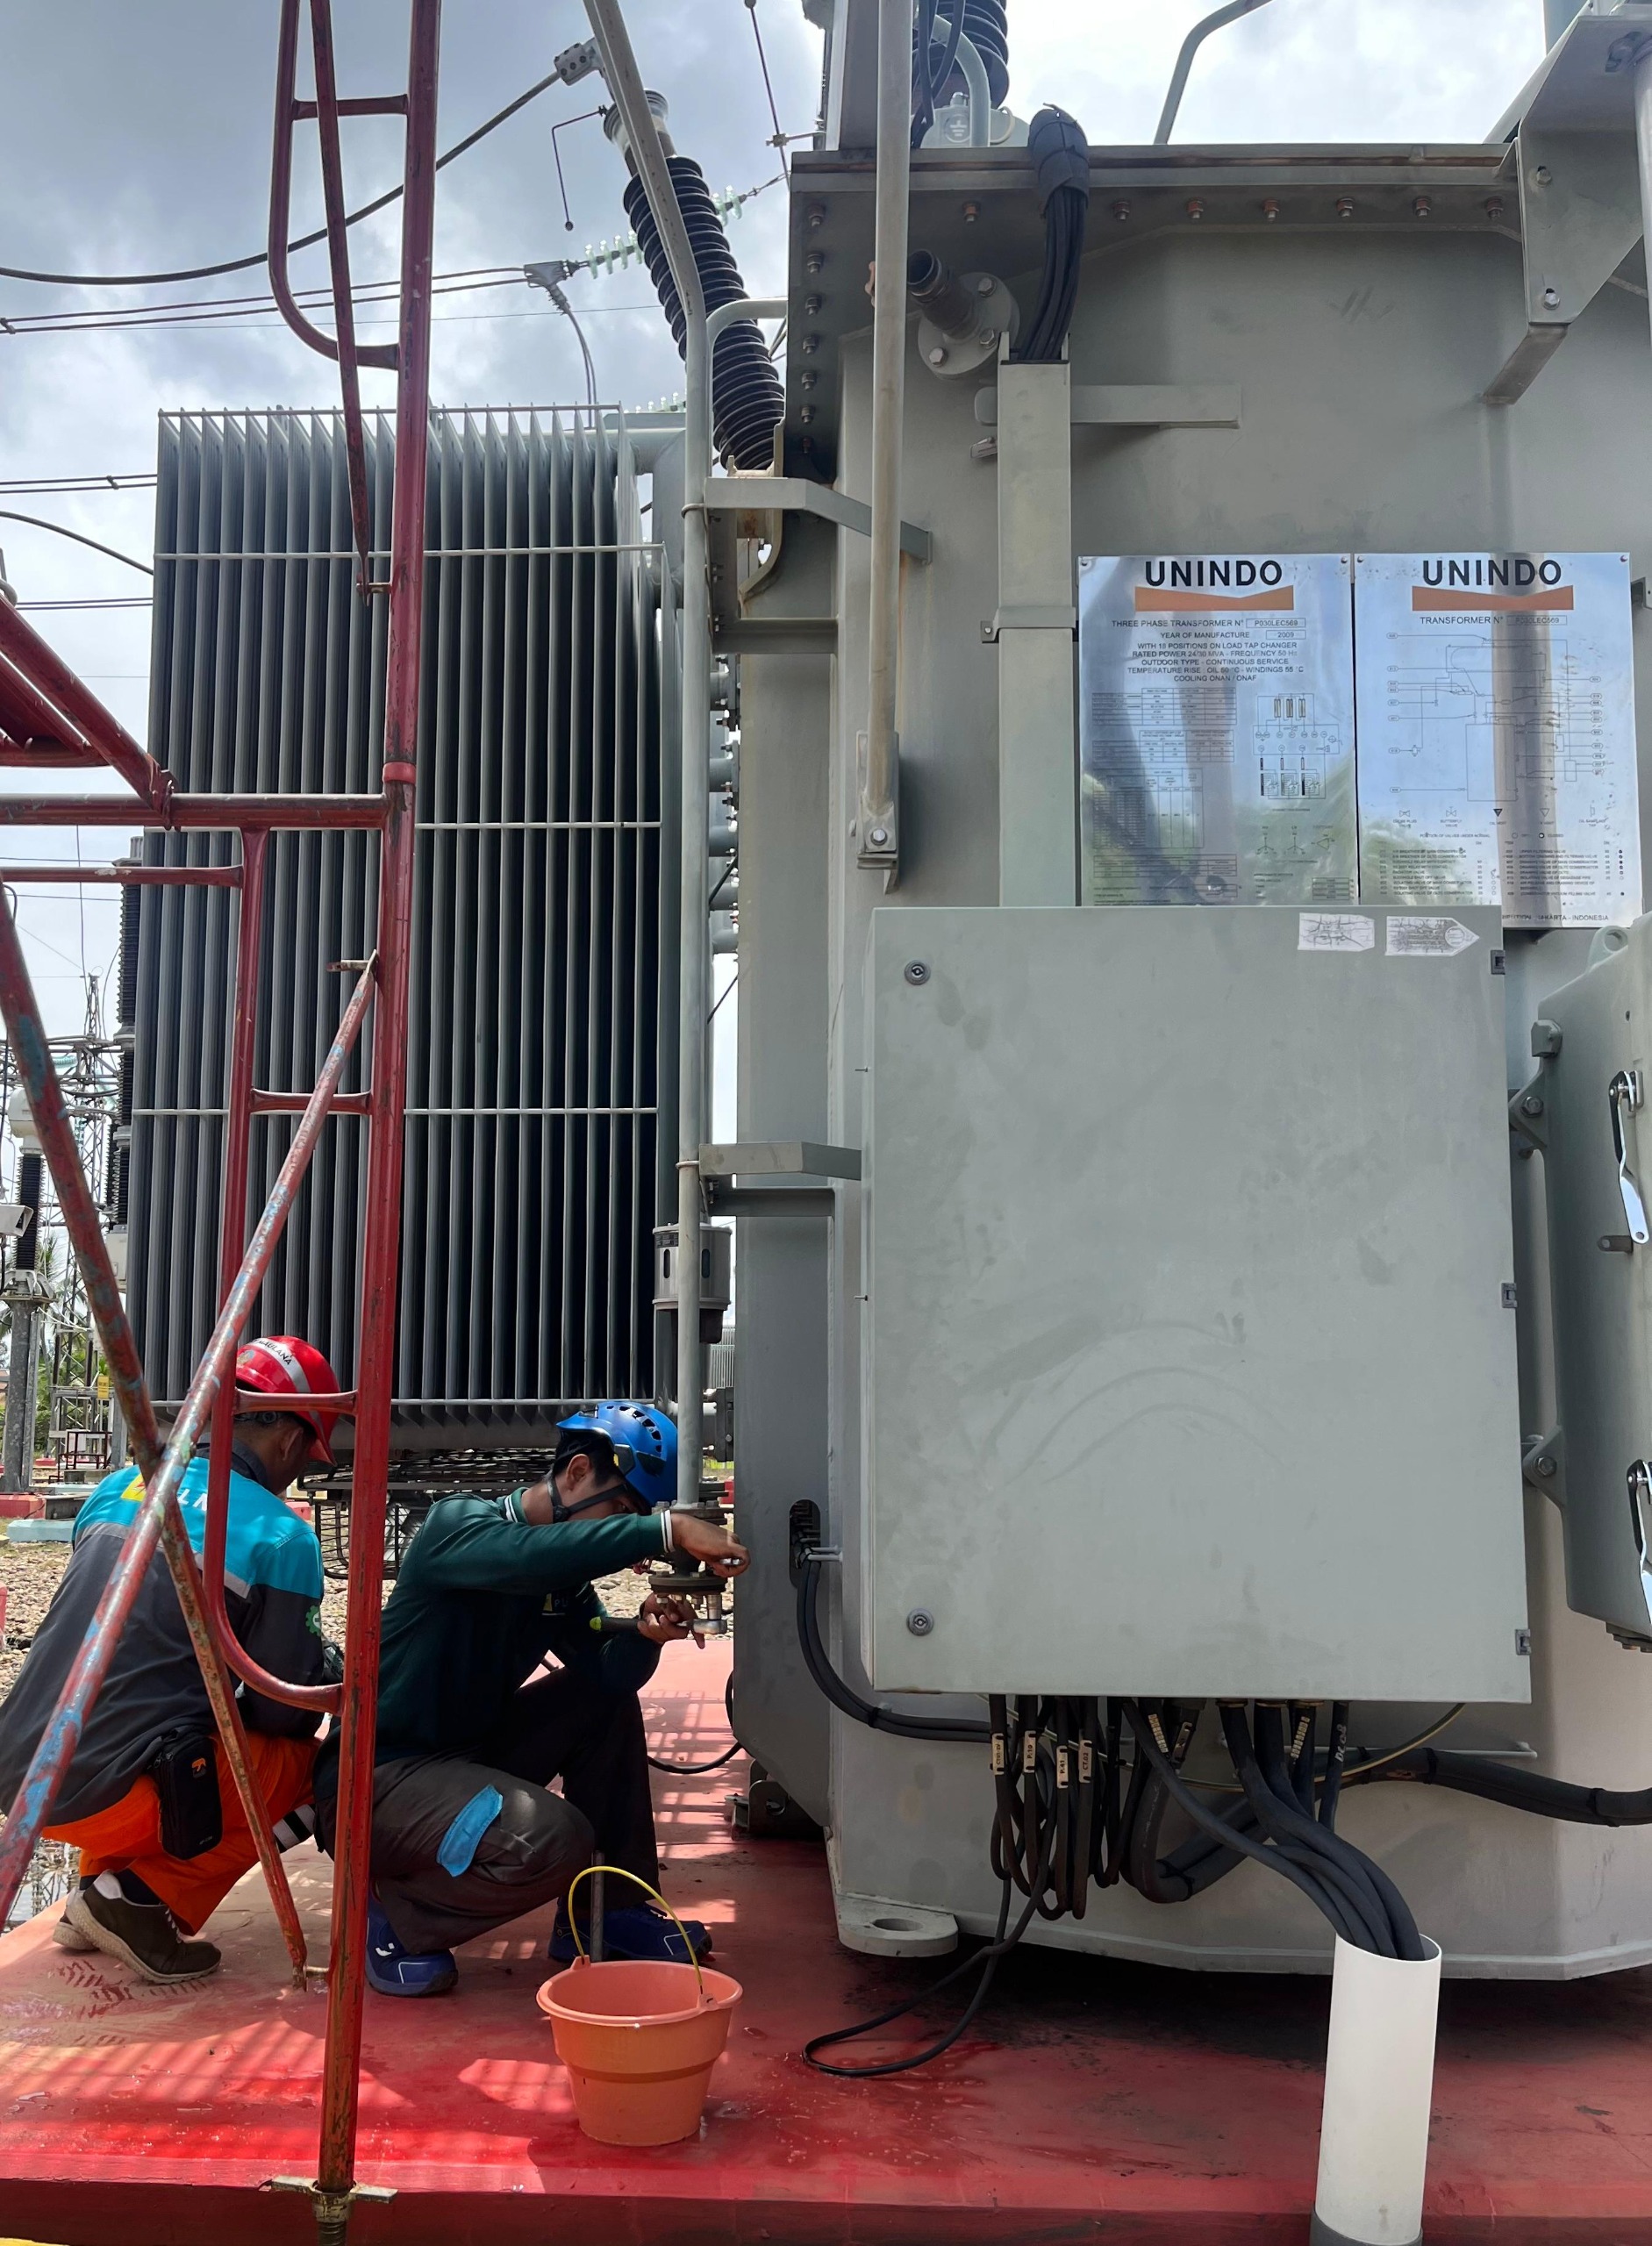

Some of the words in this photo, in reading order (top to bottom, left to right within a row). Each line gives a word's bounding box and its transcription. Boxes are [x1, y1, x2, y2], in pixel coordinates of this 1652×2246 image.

[1144, 560, 1283, 587] UNINDO
[1422, 559, 1562, 586] UNINDO
[1420, 616, 1491, 625] TRANSFORMER
